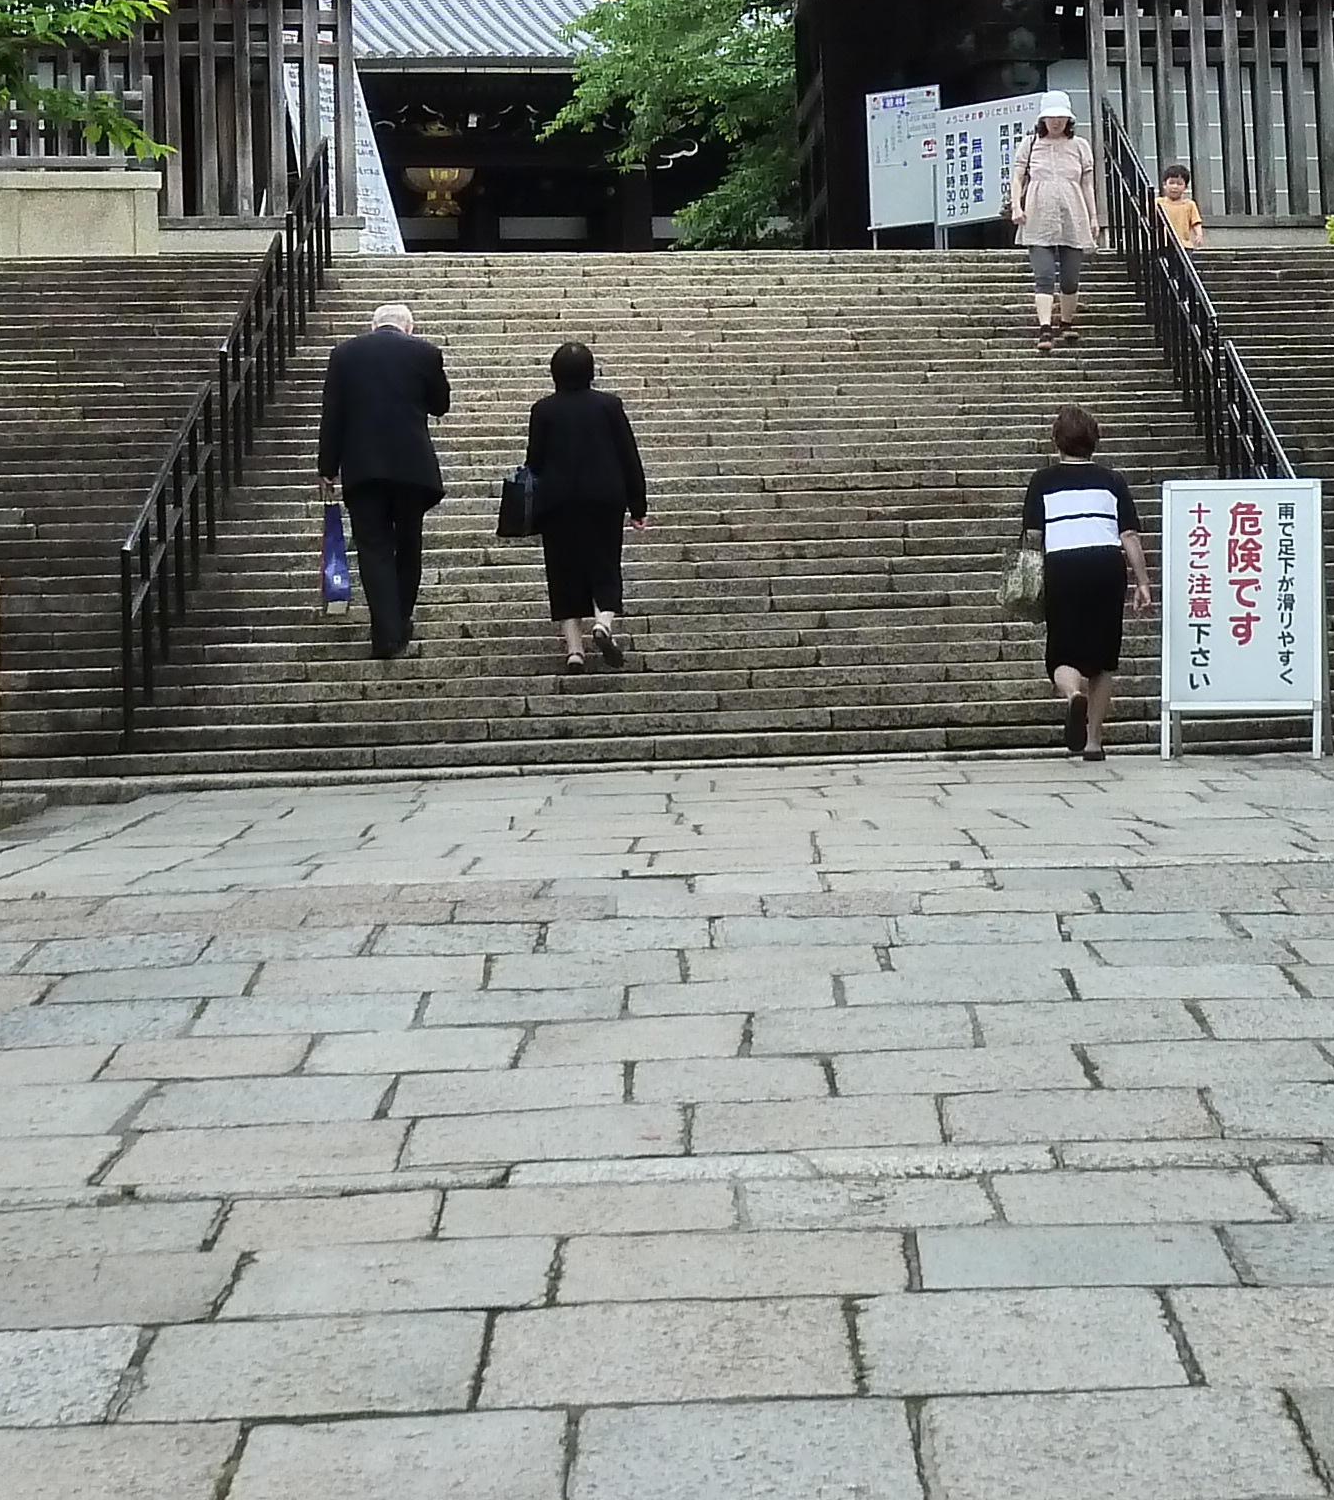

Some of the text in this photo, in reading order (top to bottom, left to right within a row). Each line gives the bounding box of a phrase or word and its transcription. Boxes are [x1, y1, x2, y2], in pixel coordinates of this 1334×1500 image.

[1188, 502, 1211, 690] 十分ご注意下さい
[1227, 501, 1263, 646] 危険です
[1277, 502, 1296, 685] 雨で足下が滑りやすく
